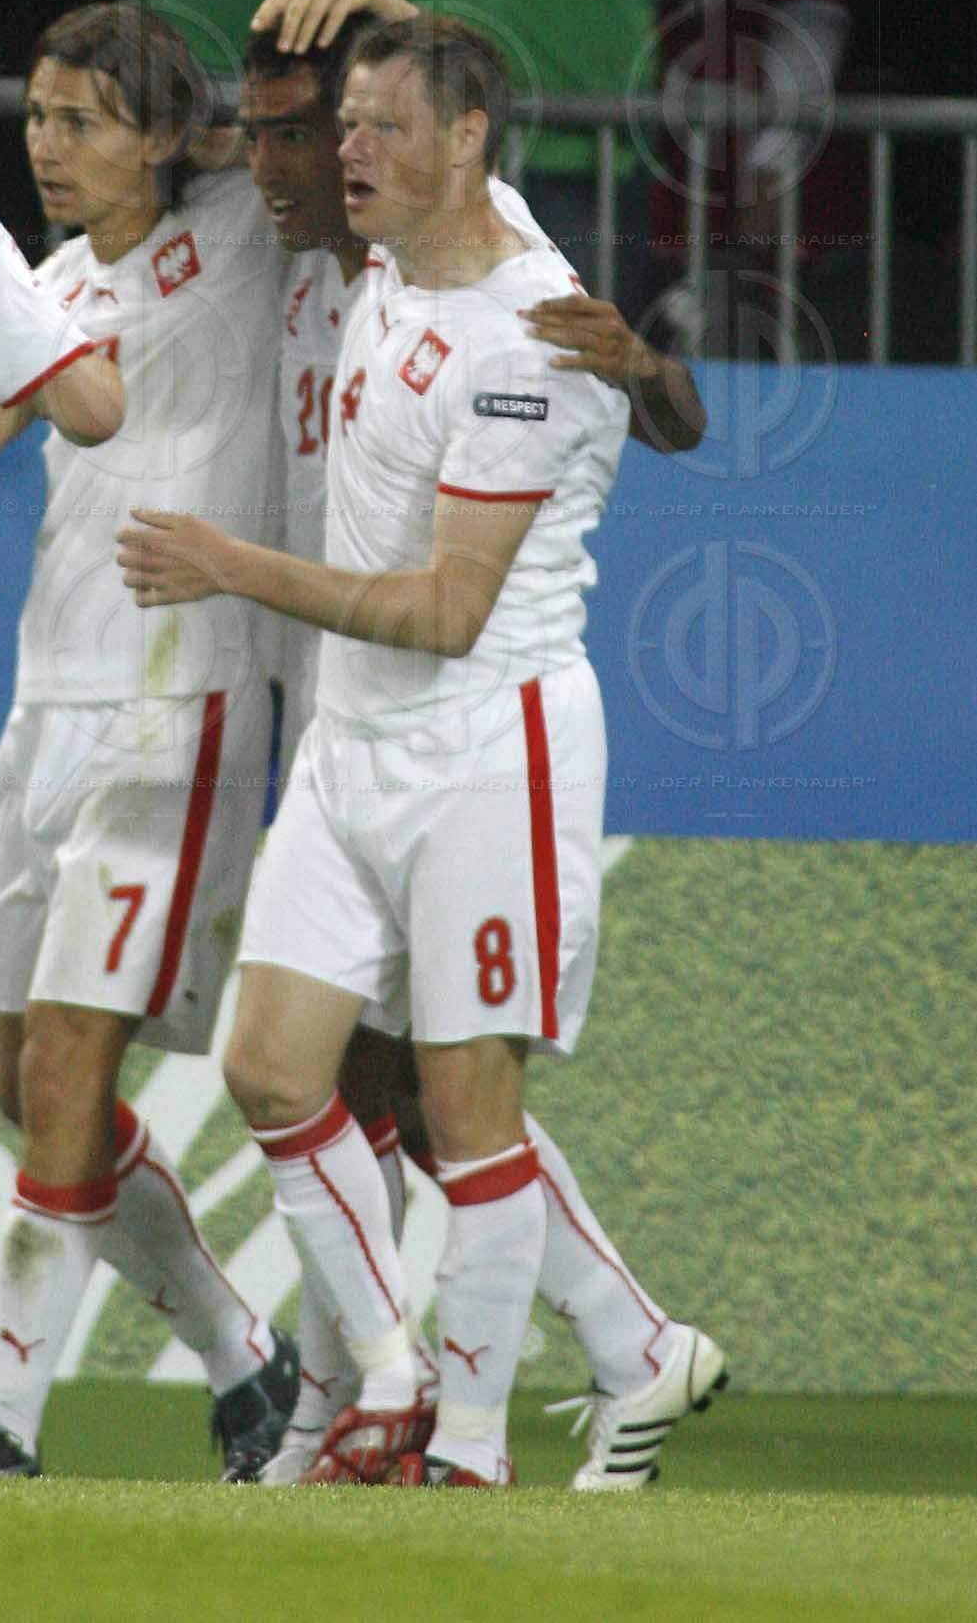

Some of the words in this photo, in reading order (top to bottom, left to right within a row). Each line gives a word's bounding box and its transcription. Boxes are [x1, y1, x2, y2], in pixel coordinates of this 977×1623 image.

[493, 398, 546, 415] RESPECT
[106, 884, 146, 974] 7
[474, 915, 517, 1006] 8
